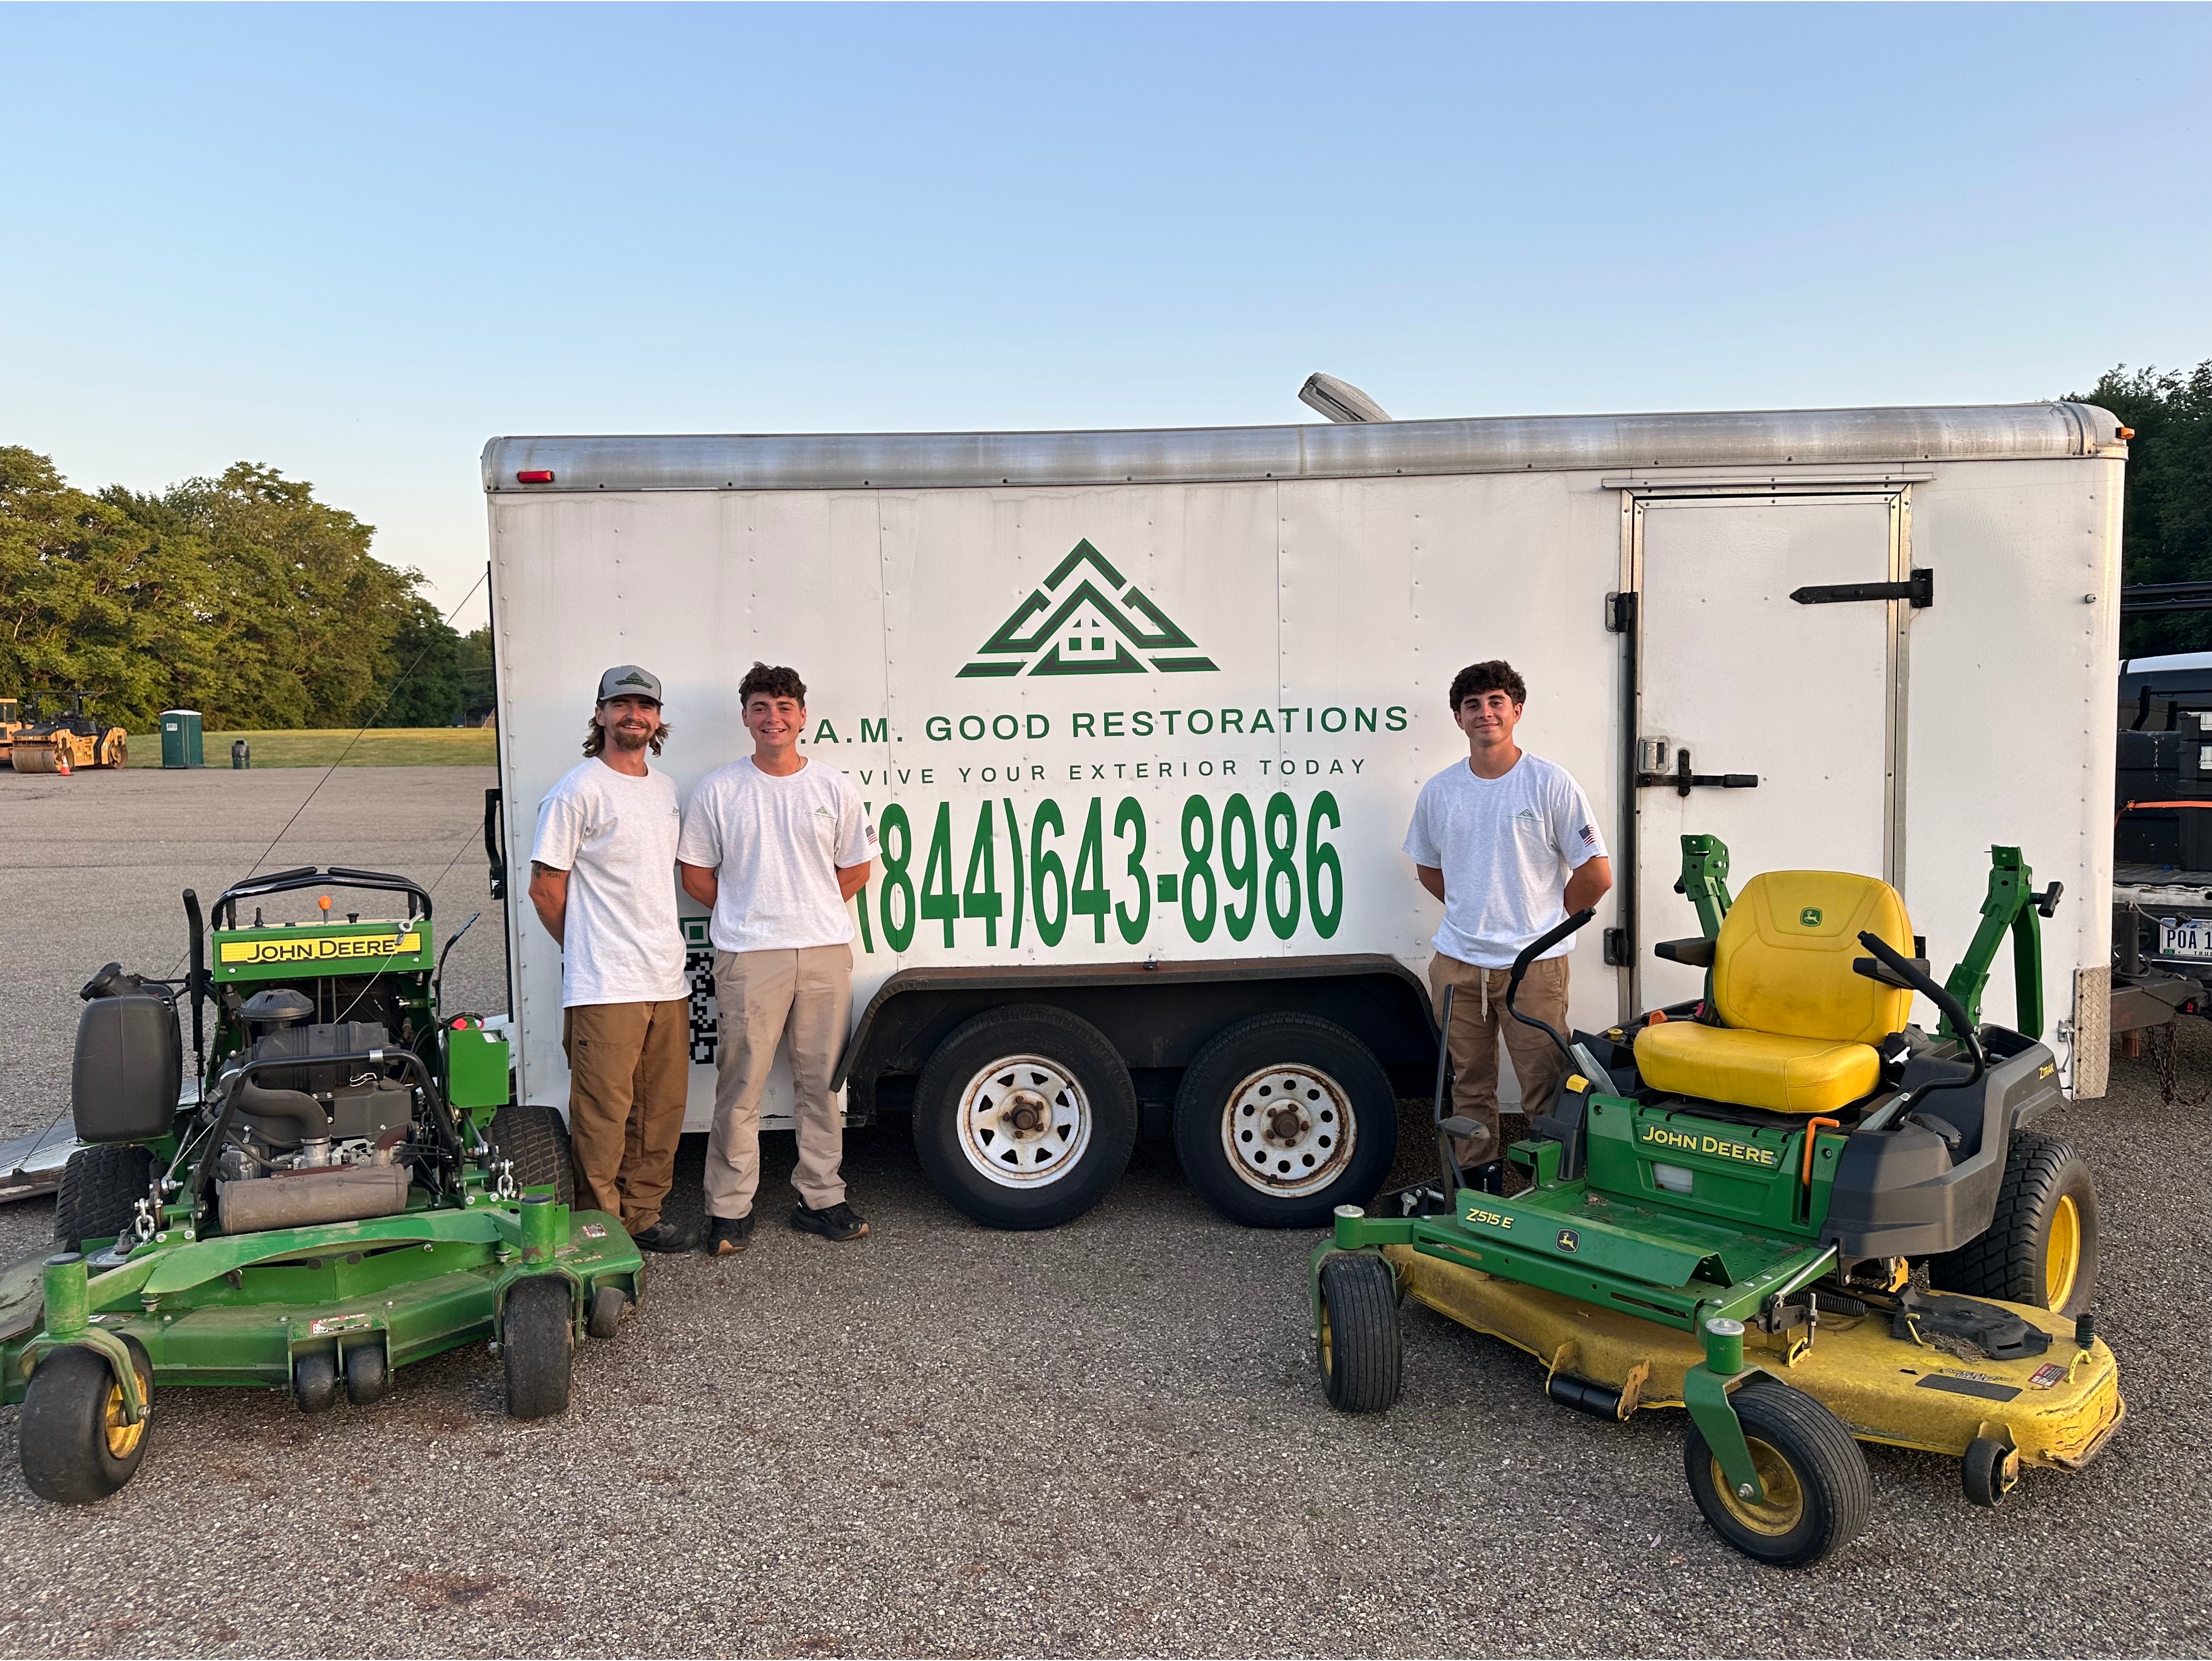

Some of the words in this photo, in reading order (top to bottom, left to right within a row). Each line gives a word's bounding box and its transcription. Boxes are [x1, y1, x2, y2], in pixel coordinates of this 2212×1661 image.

[926, 714, 1049, 742] GOOD
[1073, 706, 1407, 738] RESTORATIONS
[841, 769, 934, 786] VIVE
[958, 765, 1045, 783] YOUR
[1070, 761, 1236, 780] EXTERIOR
[1259, 759, 1364, 775] TODAY
[247, 944, 313, 961] JOHN
[319, 940, 397, 956] DEERE
[2167, 929, 2197, 949] POA
[1642, 1126, 1697, 1150] JOHN
[1702, 1135, 1774, 1165] DEERE
[1465, 1207, 1502, 1225] Z515
[1500, 1217, 1515, 1229] E
